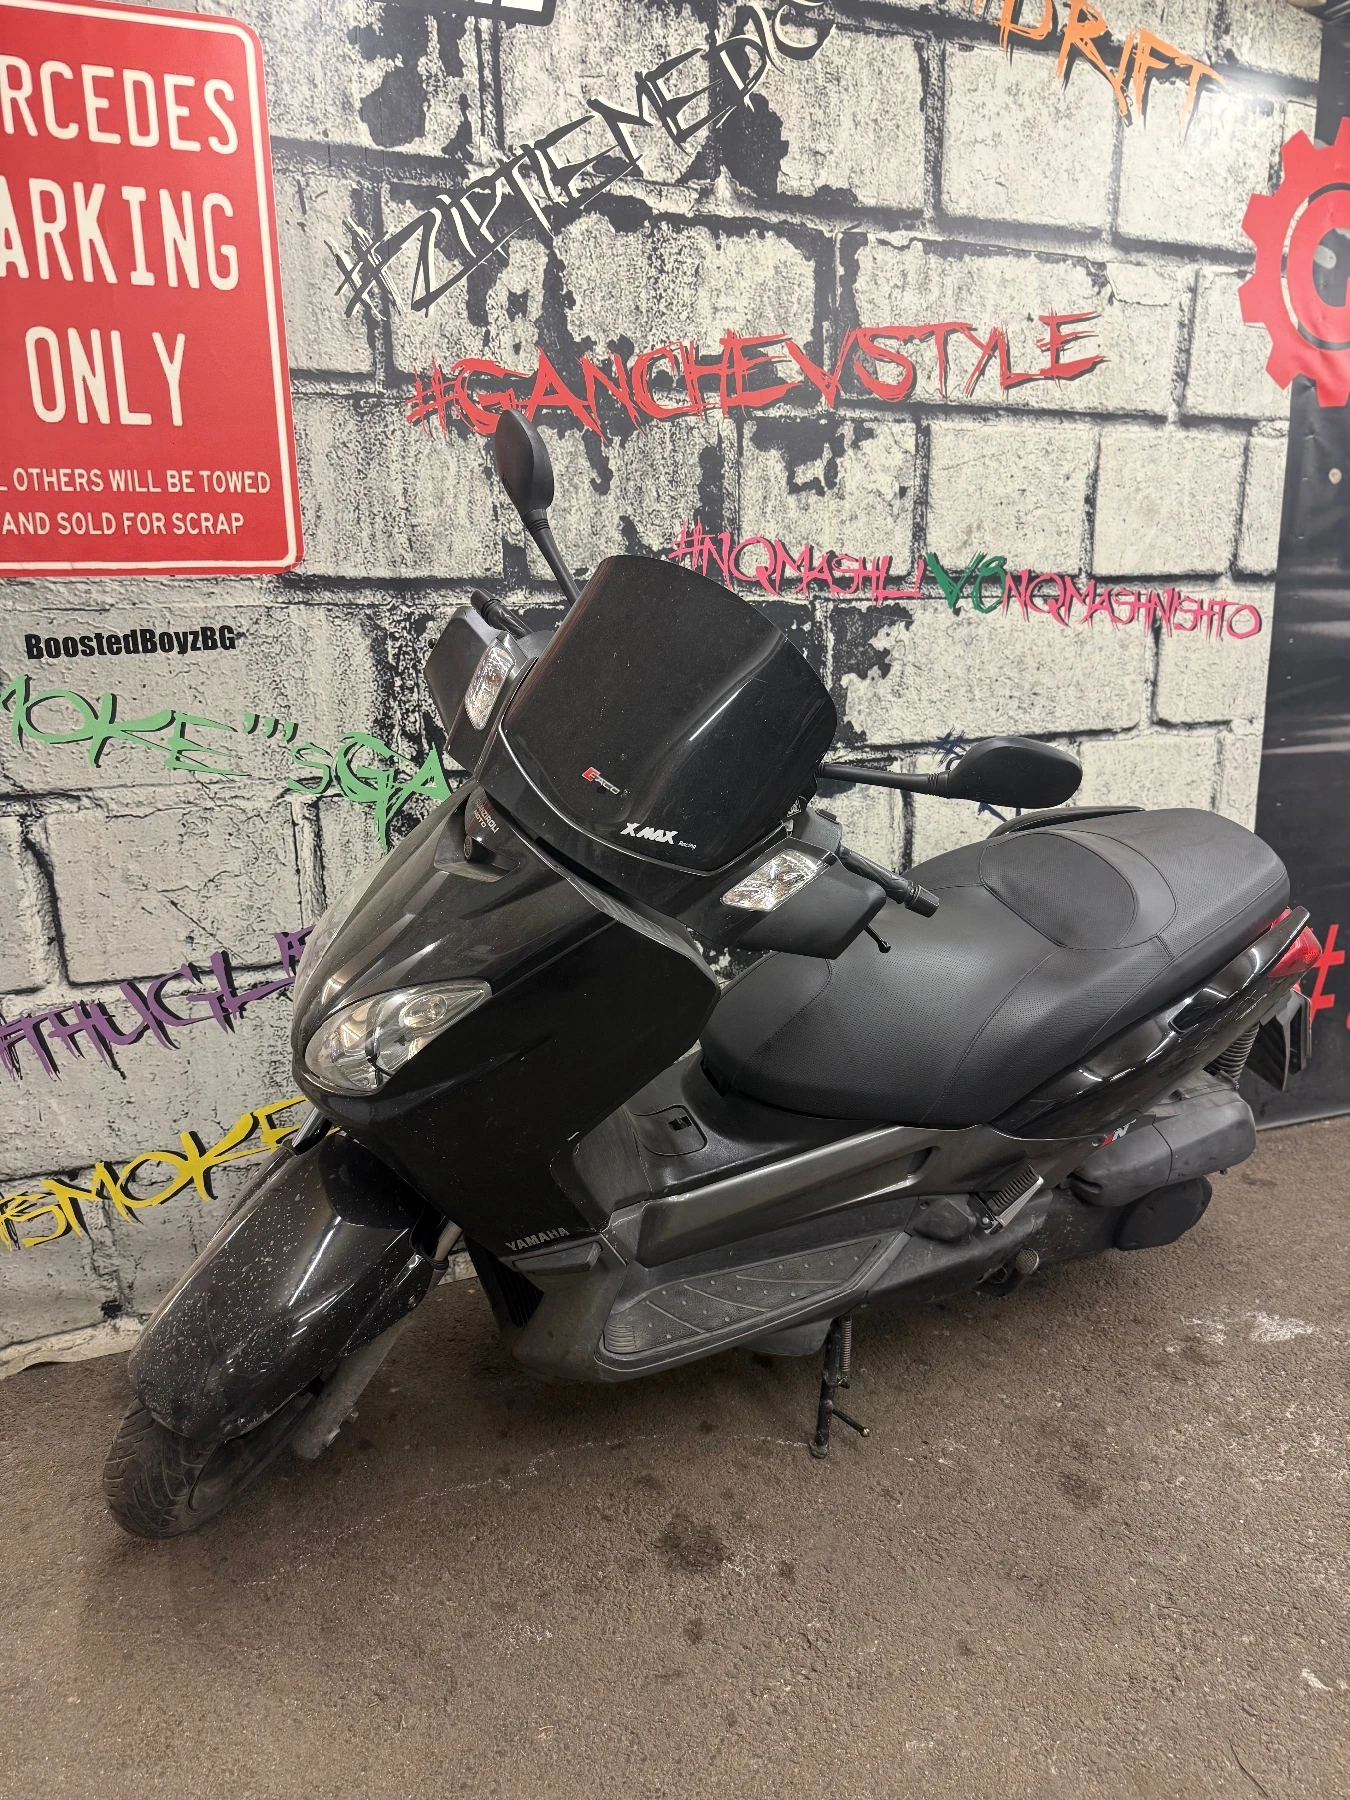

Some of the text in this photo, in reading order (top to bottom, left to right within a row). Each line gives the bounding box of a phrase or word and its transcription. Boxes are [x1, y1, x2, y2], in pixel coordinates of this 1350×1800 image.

[0, 54, 239, 155] RCEDES
[961, 0, 1228, 142] DRIFT
[24, 325, 186, 427] ONLY
[404, 306, 1110, 446] #GANCHEVSTYLE
[13, 467, 271, 494] OTHERS WILL BE TOWED
[2, 511, 244, 535] AND SOLD FOR SCRAP
[24, 625, 237, 660] BoostedBoyzBG
[504, 1227, 571, 1252] YAMAHA
